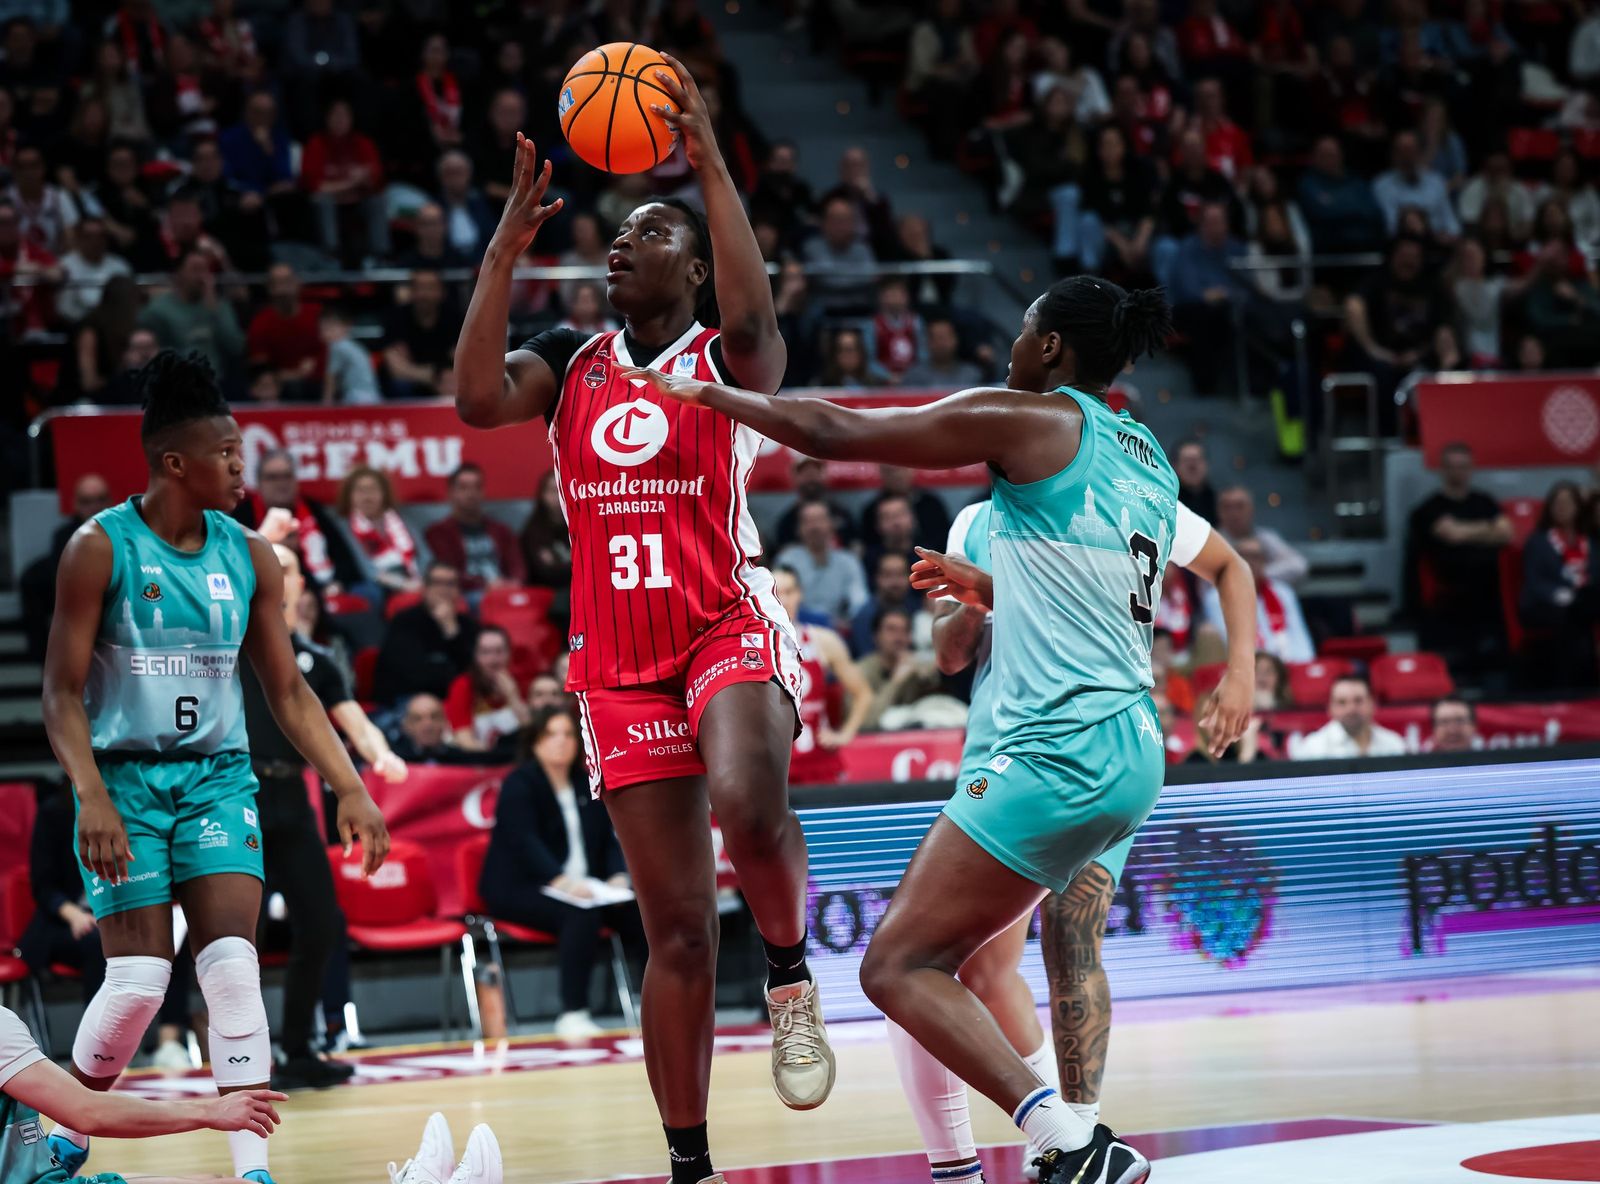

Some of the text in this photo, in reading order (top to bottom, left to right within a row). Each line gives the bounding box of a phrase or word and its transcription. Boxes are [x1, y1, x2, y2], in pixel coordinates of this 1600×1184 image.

[569, 472, 706, 502] Casademont
[598, 500, 666, 516] ZARAGOZA
[608, 533, 673, 590] 31
[1129, 530, 1159, 624] 3
[130, 655, 188, 676] SGM
[693, 656, 738, 689] Zaragoza
[695, 663, 738, 698] DEPORTE
[174, 696, 199, 732] 6
[627, 719, 693, 744] Silke
[648, 742, 693, 757] HOTELES
